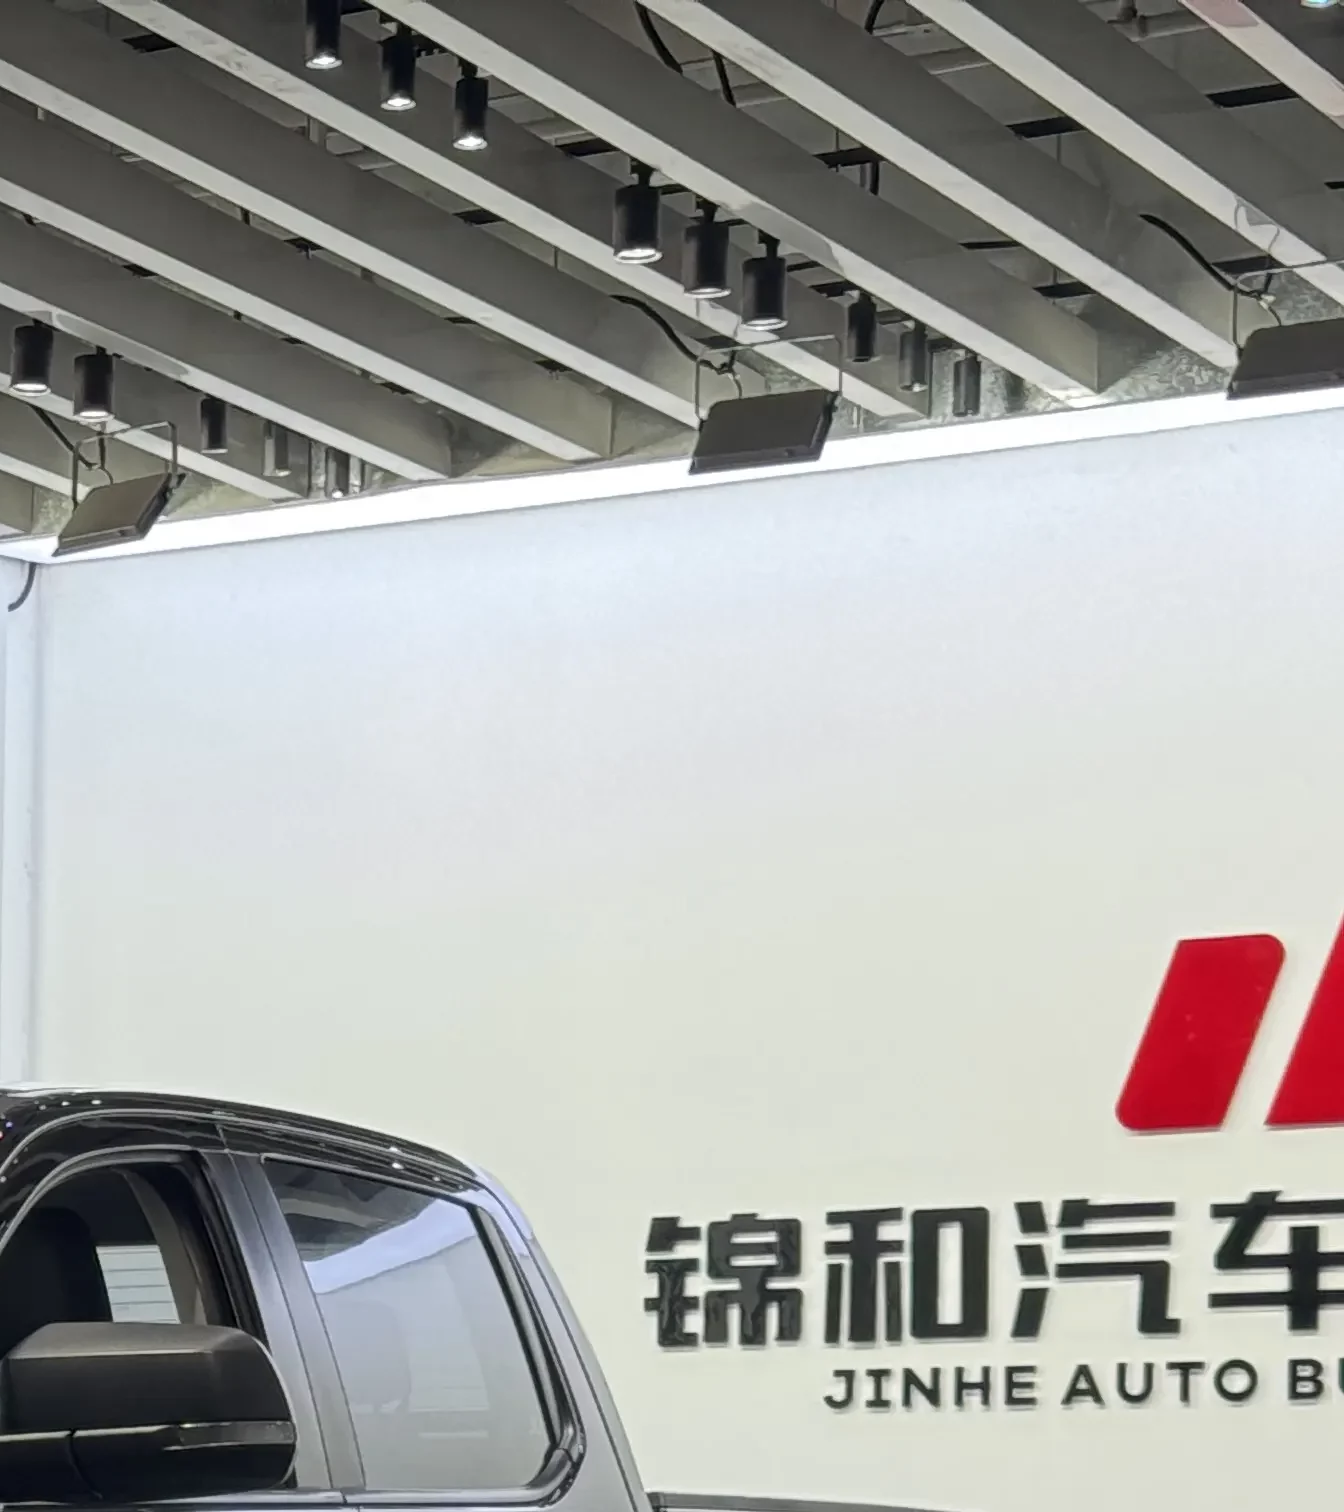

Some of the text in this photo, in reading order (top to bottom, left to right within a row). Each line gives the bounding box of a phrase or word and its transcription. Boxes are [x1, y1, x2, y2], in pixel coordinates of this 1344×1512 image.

[643, 1190, 1344, 1350] 锦和汽车
[823, 1357, 1344, 1410] JINHE AUTO B
